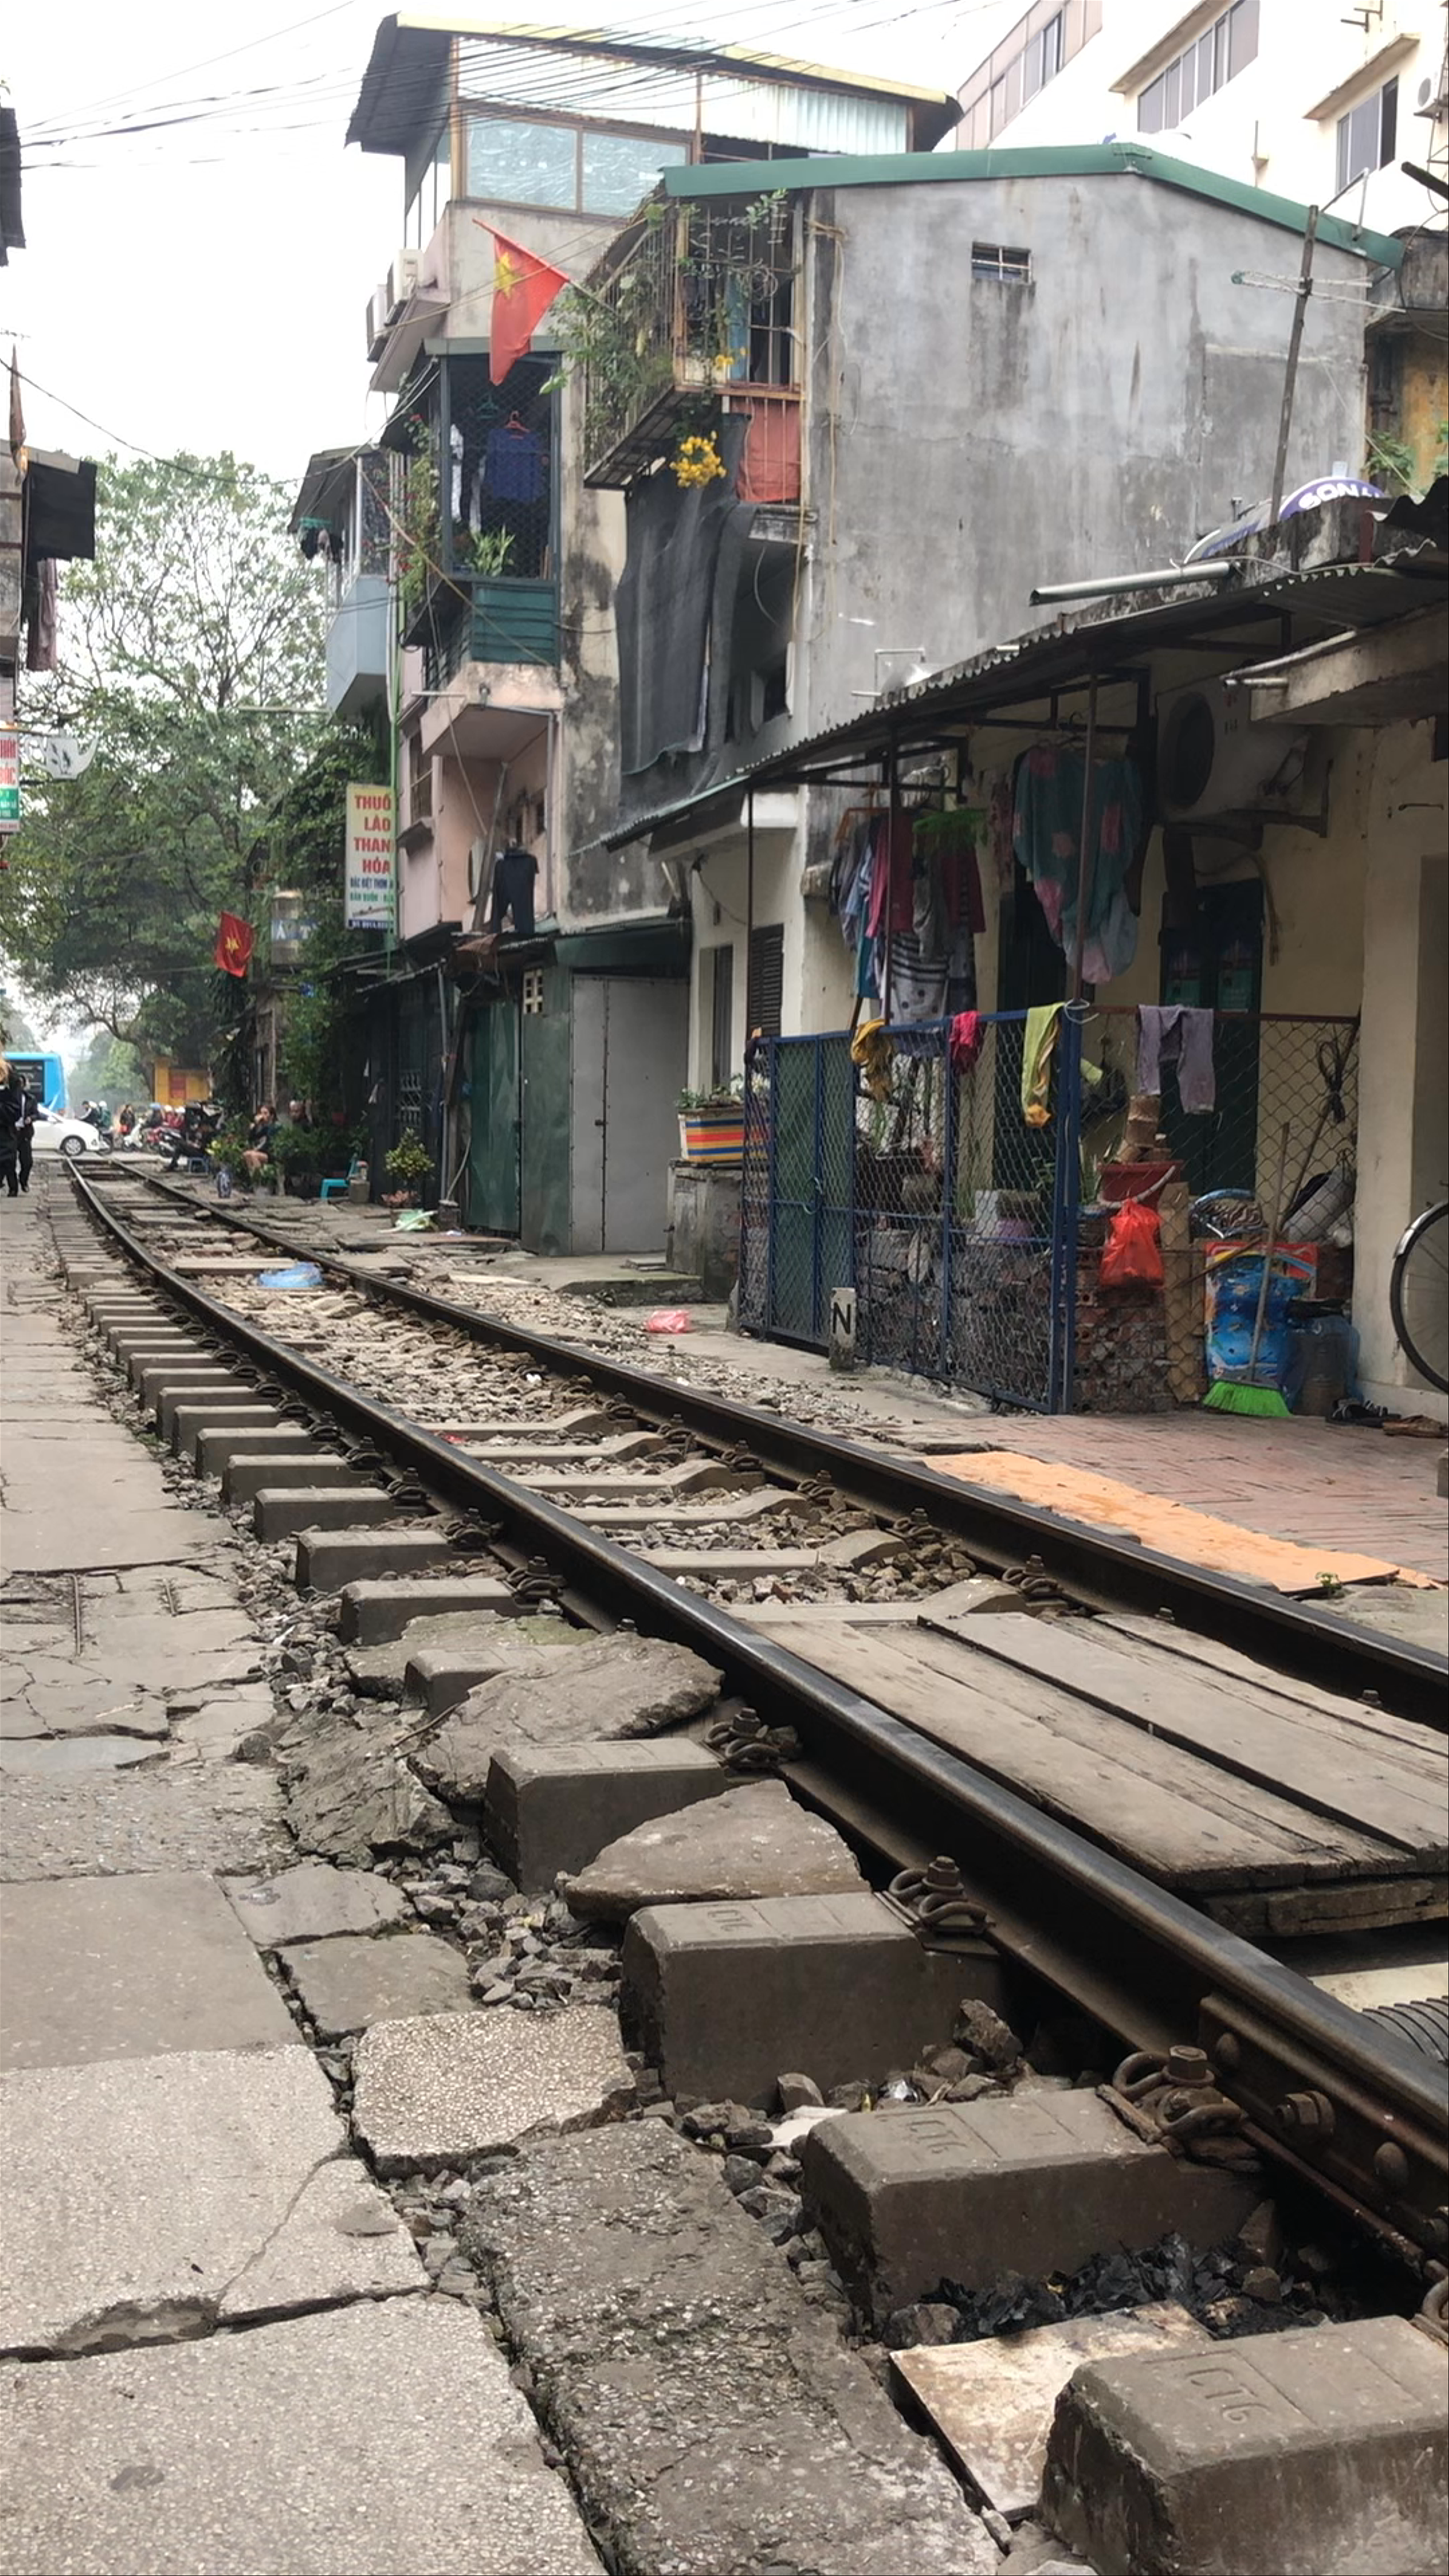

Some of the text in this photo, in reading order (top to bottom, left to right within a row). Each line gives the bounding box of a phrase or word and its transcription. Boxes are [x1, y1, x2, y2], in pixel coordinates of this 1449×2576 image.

[355, 794, 392, 811] THUỐ
[364, 815, 391, 832] LÀO
[832, 1302, 851, 1335] N
[1184, 2367, 1270, 2424] CT6
